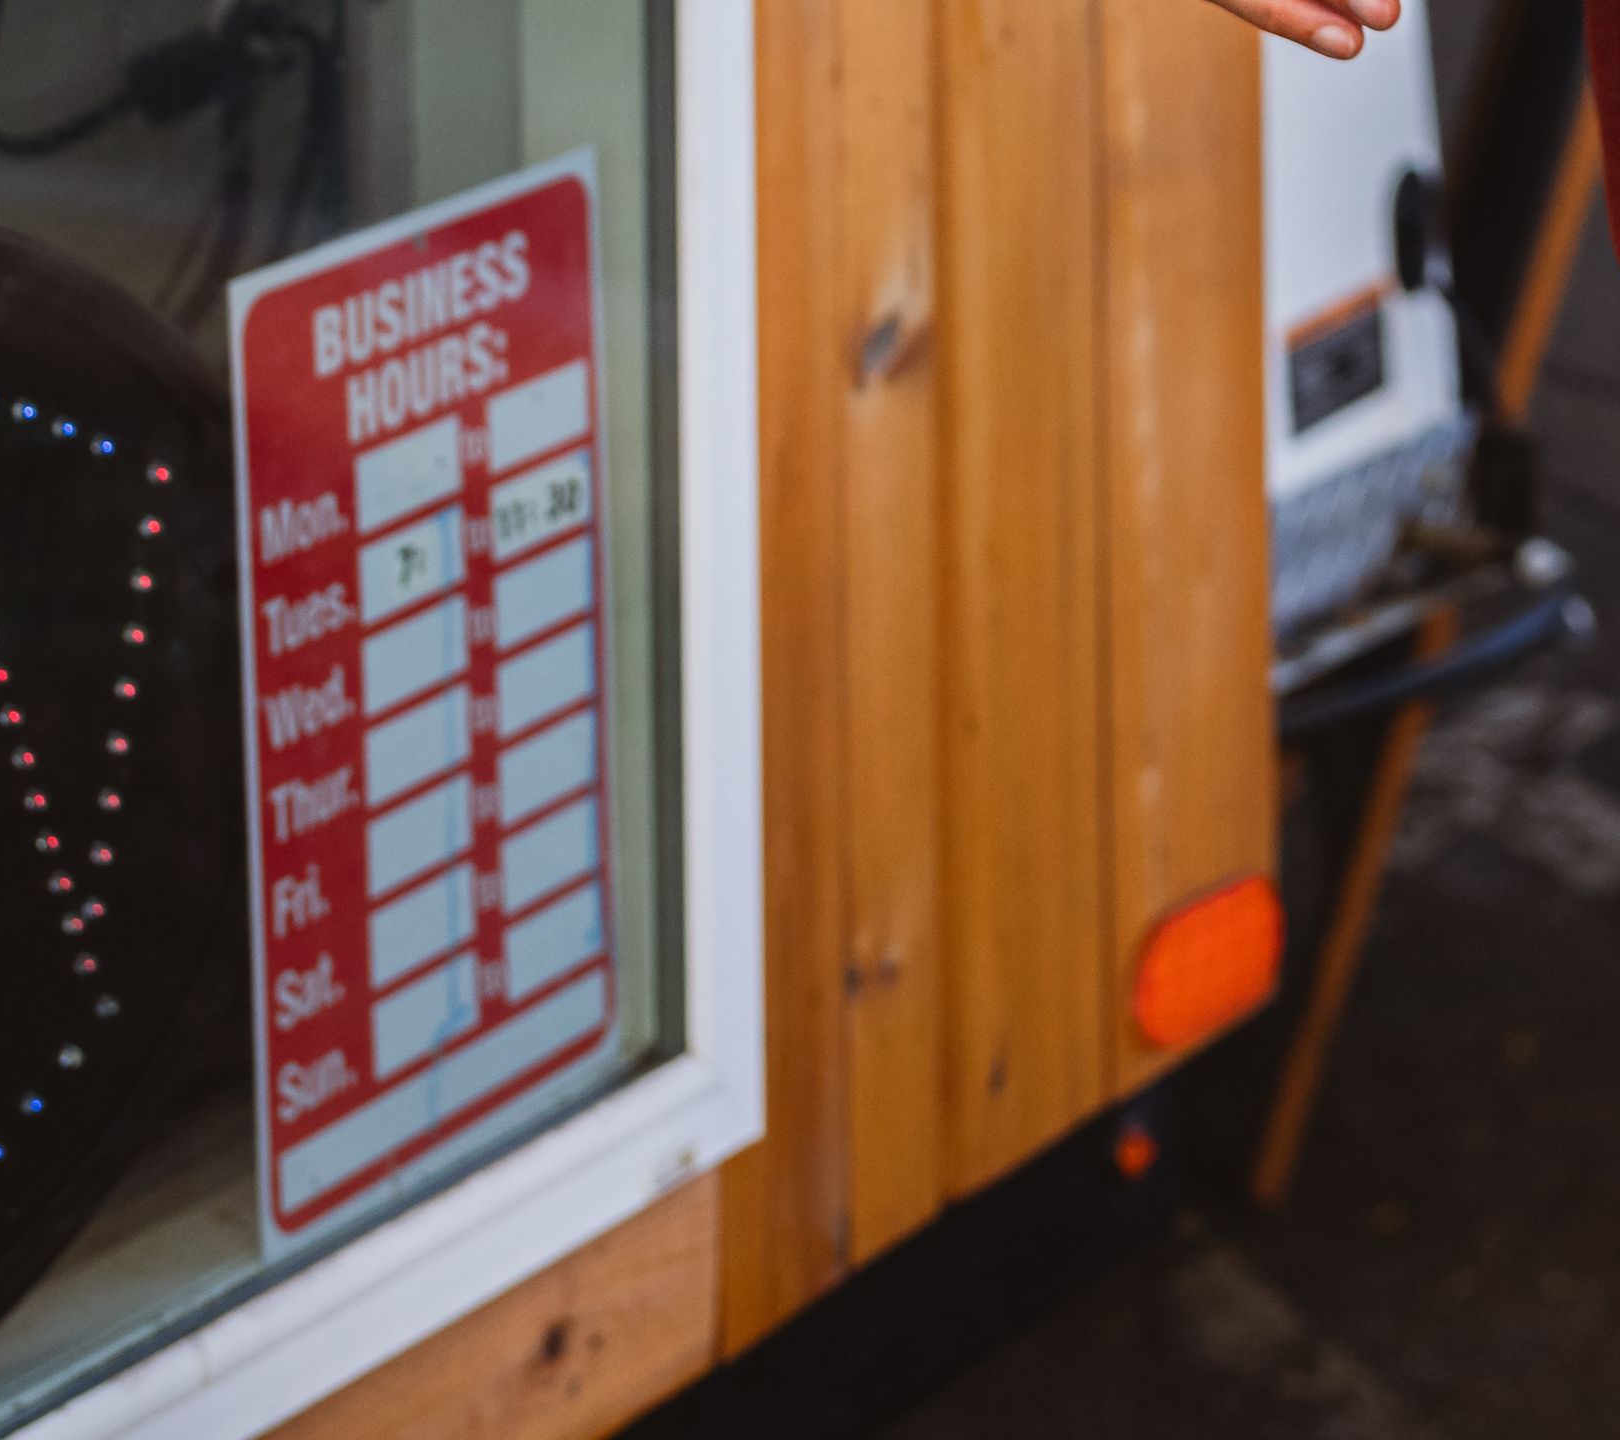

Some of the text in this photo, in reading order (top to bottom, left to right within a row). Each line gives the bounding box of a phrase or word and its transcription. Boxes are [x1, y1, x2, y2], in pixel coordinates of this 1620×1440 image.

[314, 232, 529, 378] BUSINESS
[346, 322, 508, 444] HOURS:
[260, 491, 349, 564] Mon.
[261, 581, 357, 657] Tues.
[262, 664, 357, 751] Wed.
[272, 862, 331, 939] Fri.
[275, 950, 347, 1030] Sat.
[277, 1047, 360, 1121] Sun.
